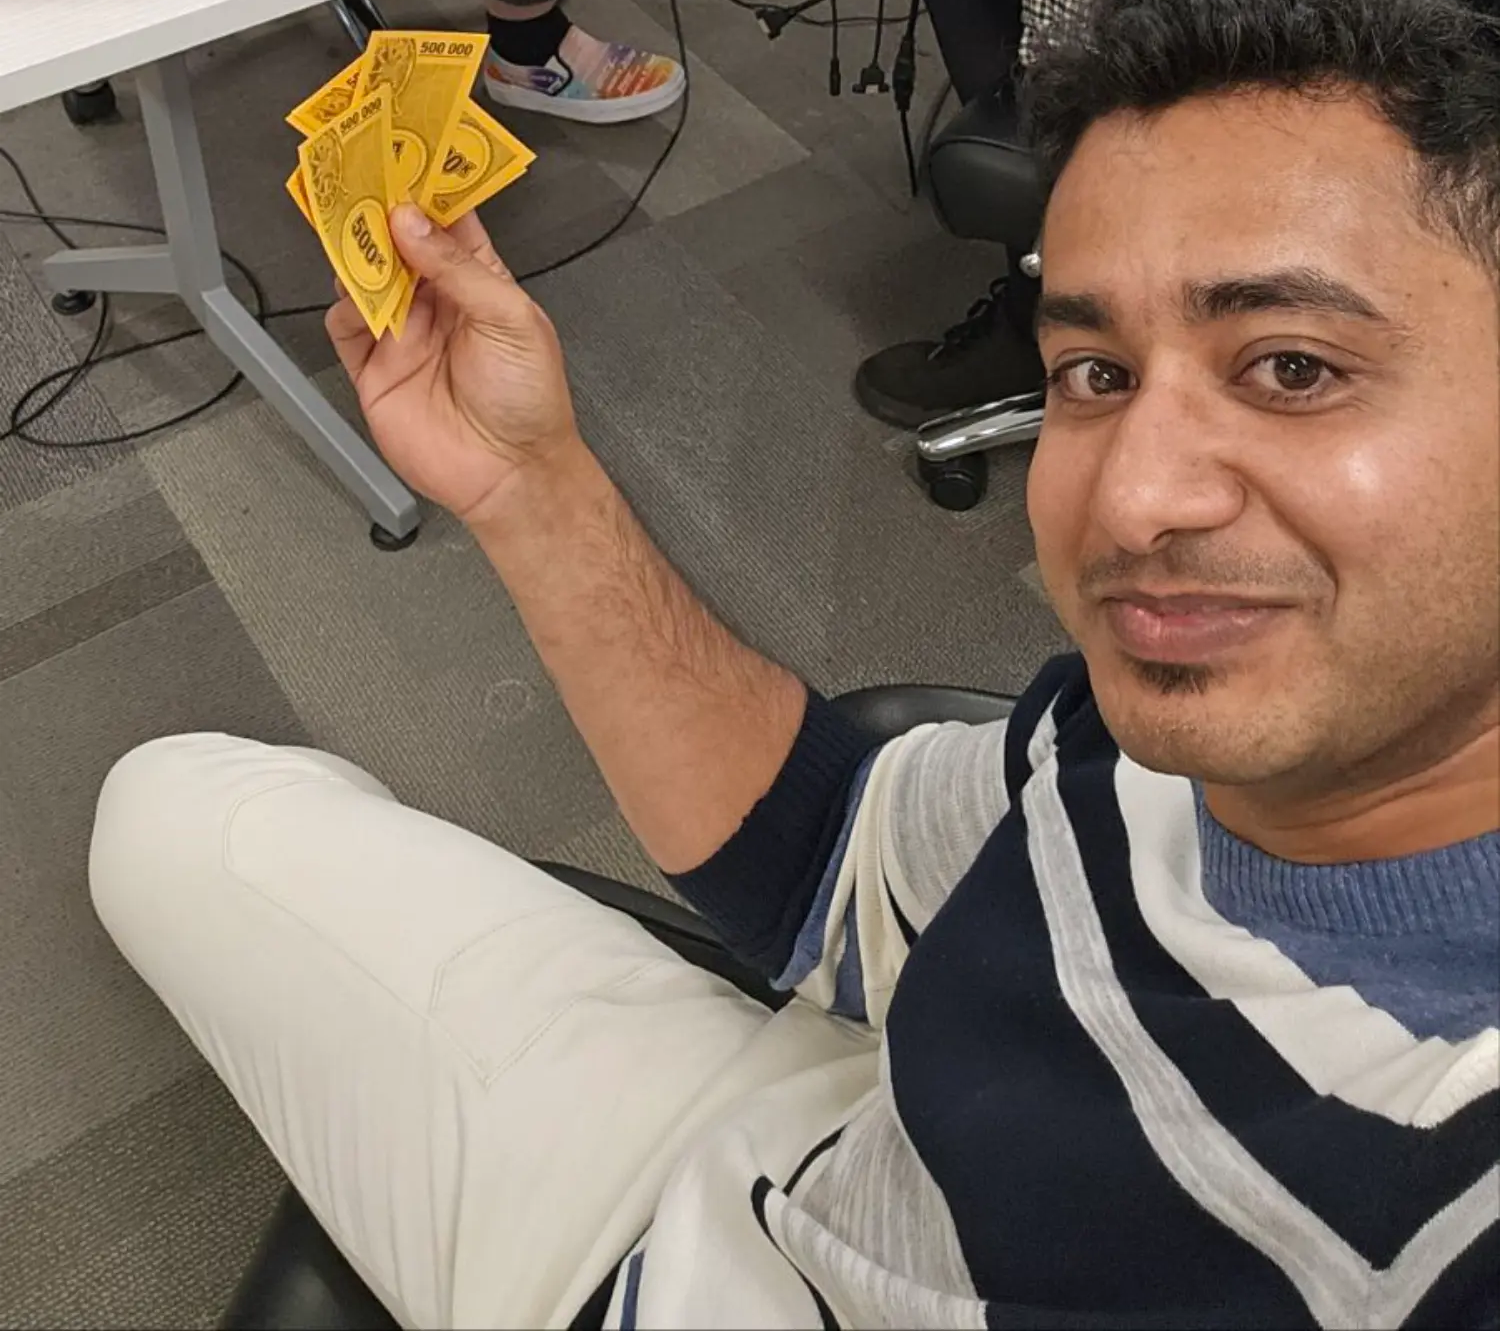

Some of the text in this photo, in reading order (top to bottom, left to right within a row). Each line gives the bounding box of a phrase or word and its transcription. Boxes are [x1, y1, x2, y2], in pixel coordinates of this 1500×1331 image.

[420, 42, 474, 55] 500 000
[340, 97, 383, 132] 500 000
